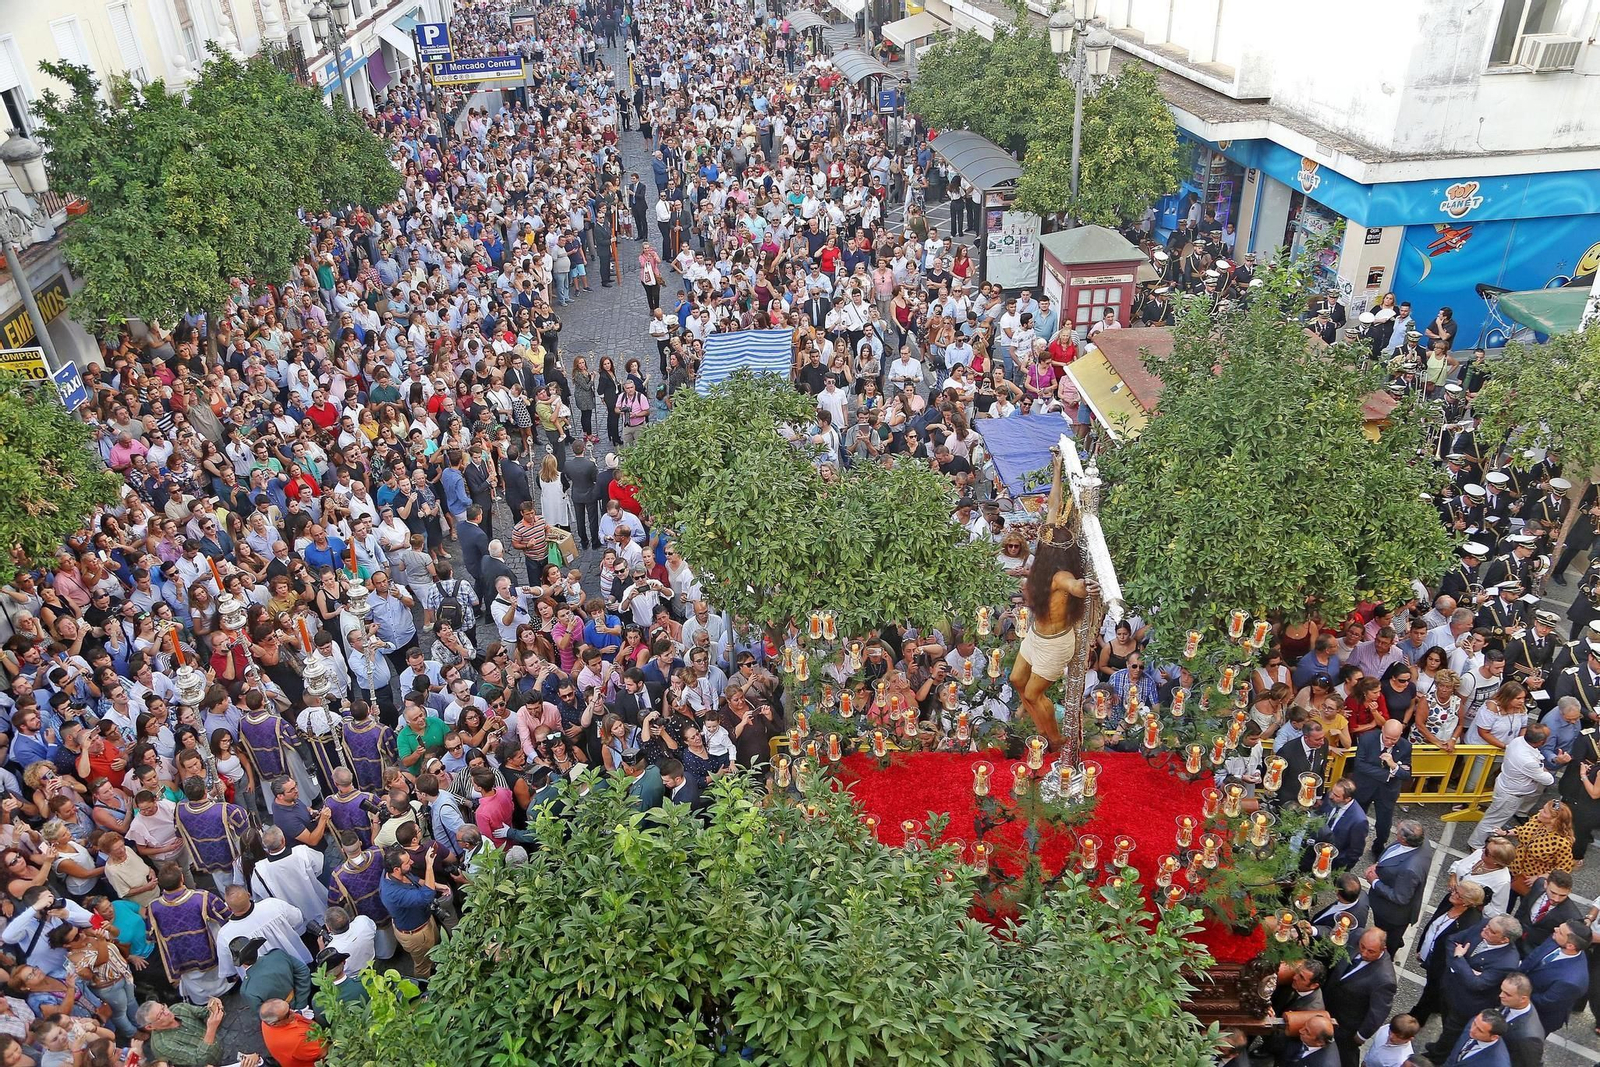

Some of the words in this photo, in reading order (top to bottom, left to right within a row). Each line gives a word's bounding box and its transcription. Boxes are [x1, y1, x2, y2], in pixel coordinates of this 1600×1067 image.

[424, 25, 440, 45] P
[435, 63, 443, 74] P
[450, 61, 485, 71] Mercado
[1448, 183, 1478, 200] TOY
[1441, 197, 1482, 210] PLANET
[60, 374, 82, 399] TAXI
